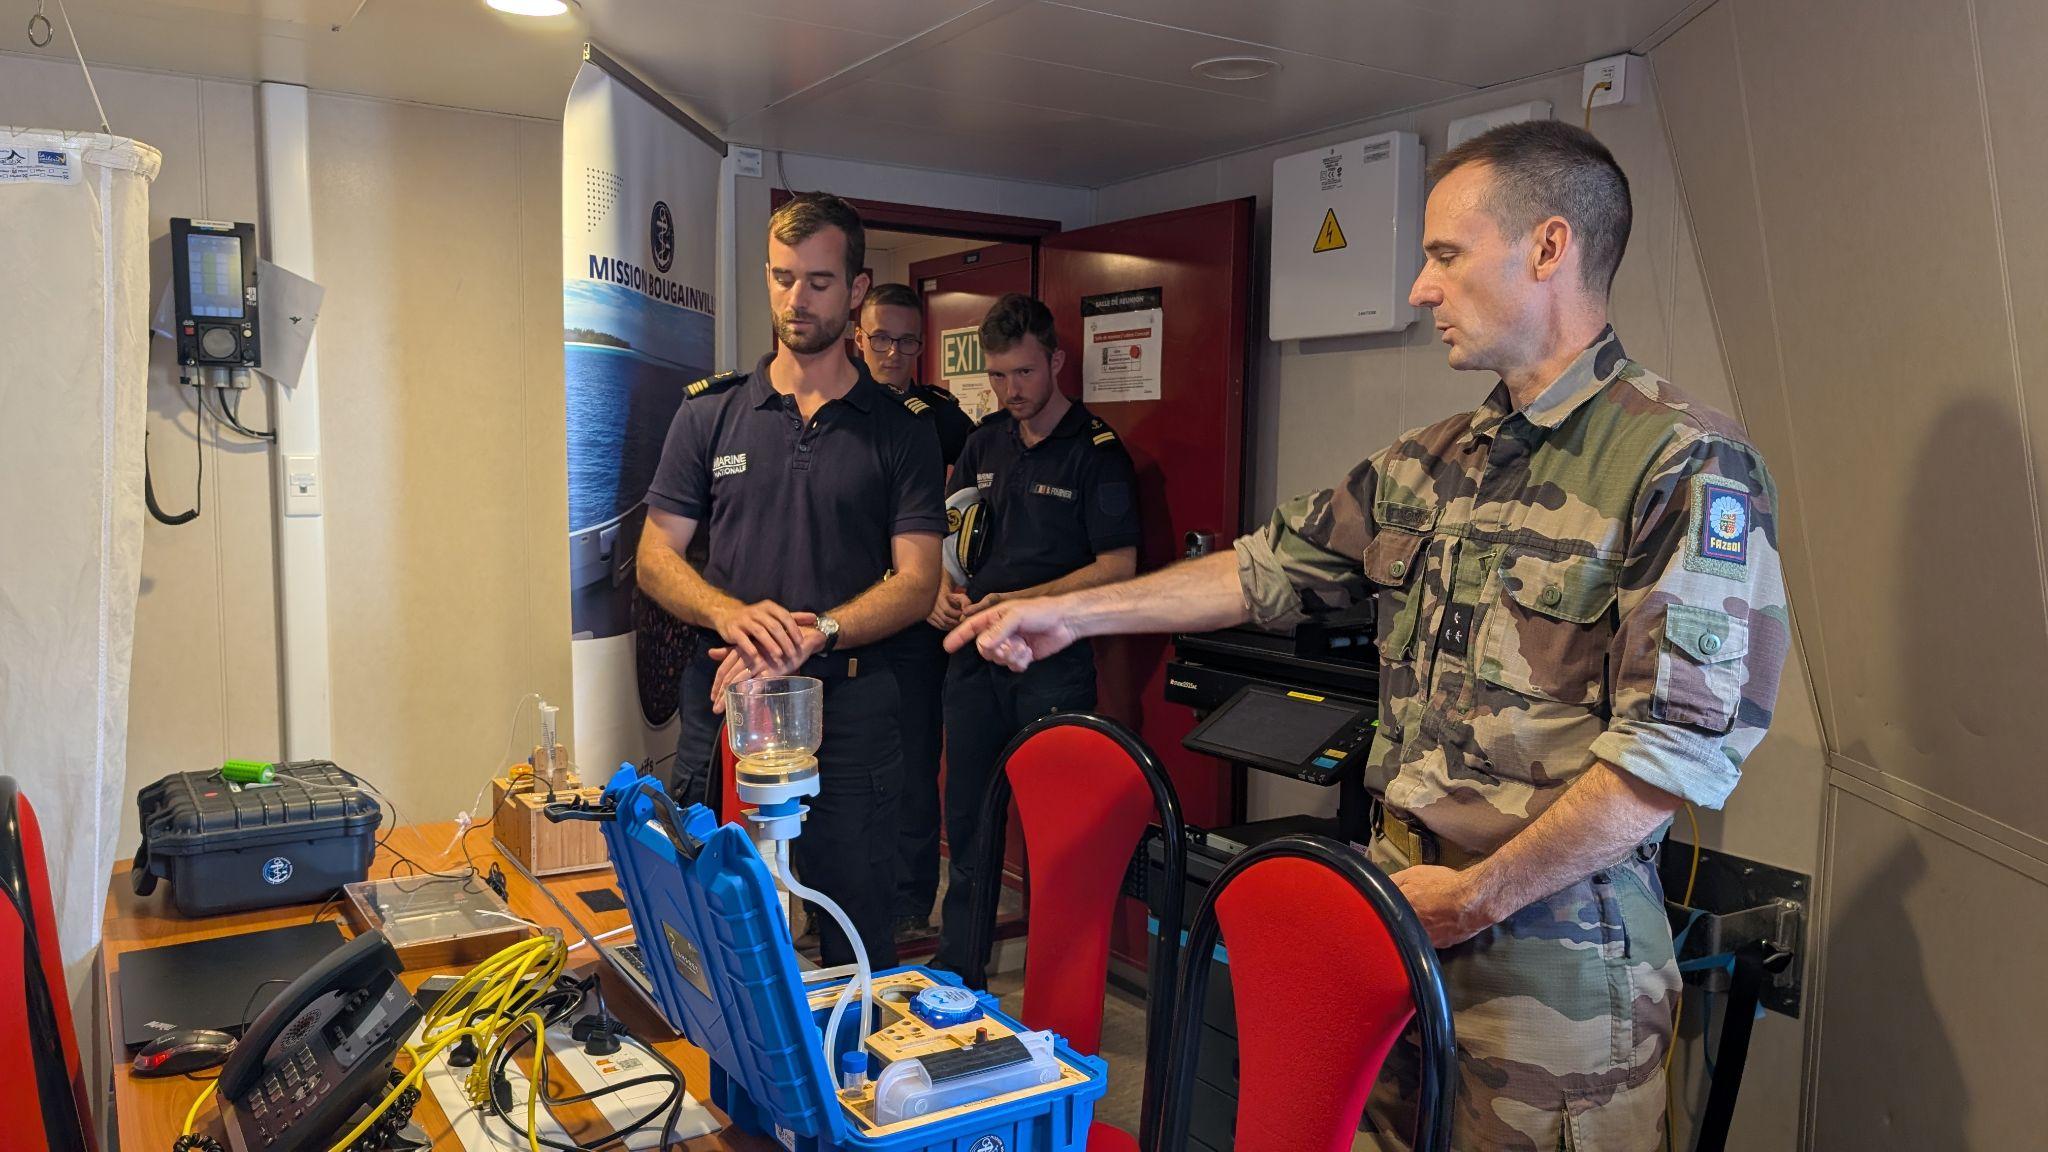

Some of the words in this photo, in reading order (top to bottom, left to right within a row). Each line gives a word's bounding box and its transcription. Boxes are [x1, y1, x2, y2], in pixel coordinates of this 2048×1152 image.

[589, 254, 648, 294] MISSION
[648, 273, 716, 315] BOUGAINVILL
[945, 334, 980, 373] EXIT
[713, 453, 747, 468] MARINE
[714, 464, 747, 478] NATIONALE
